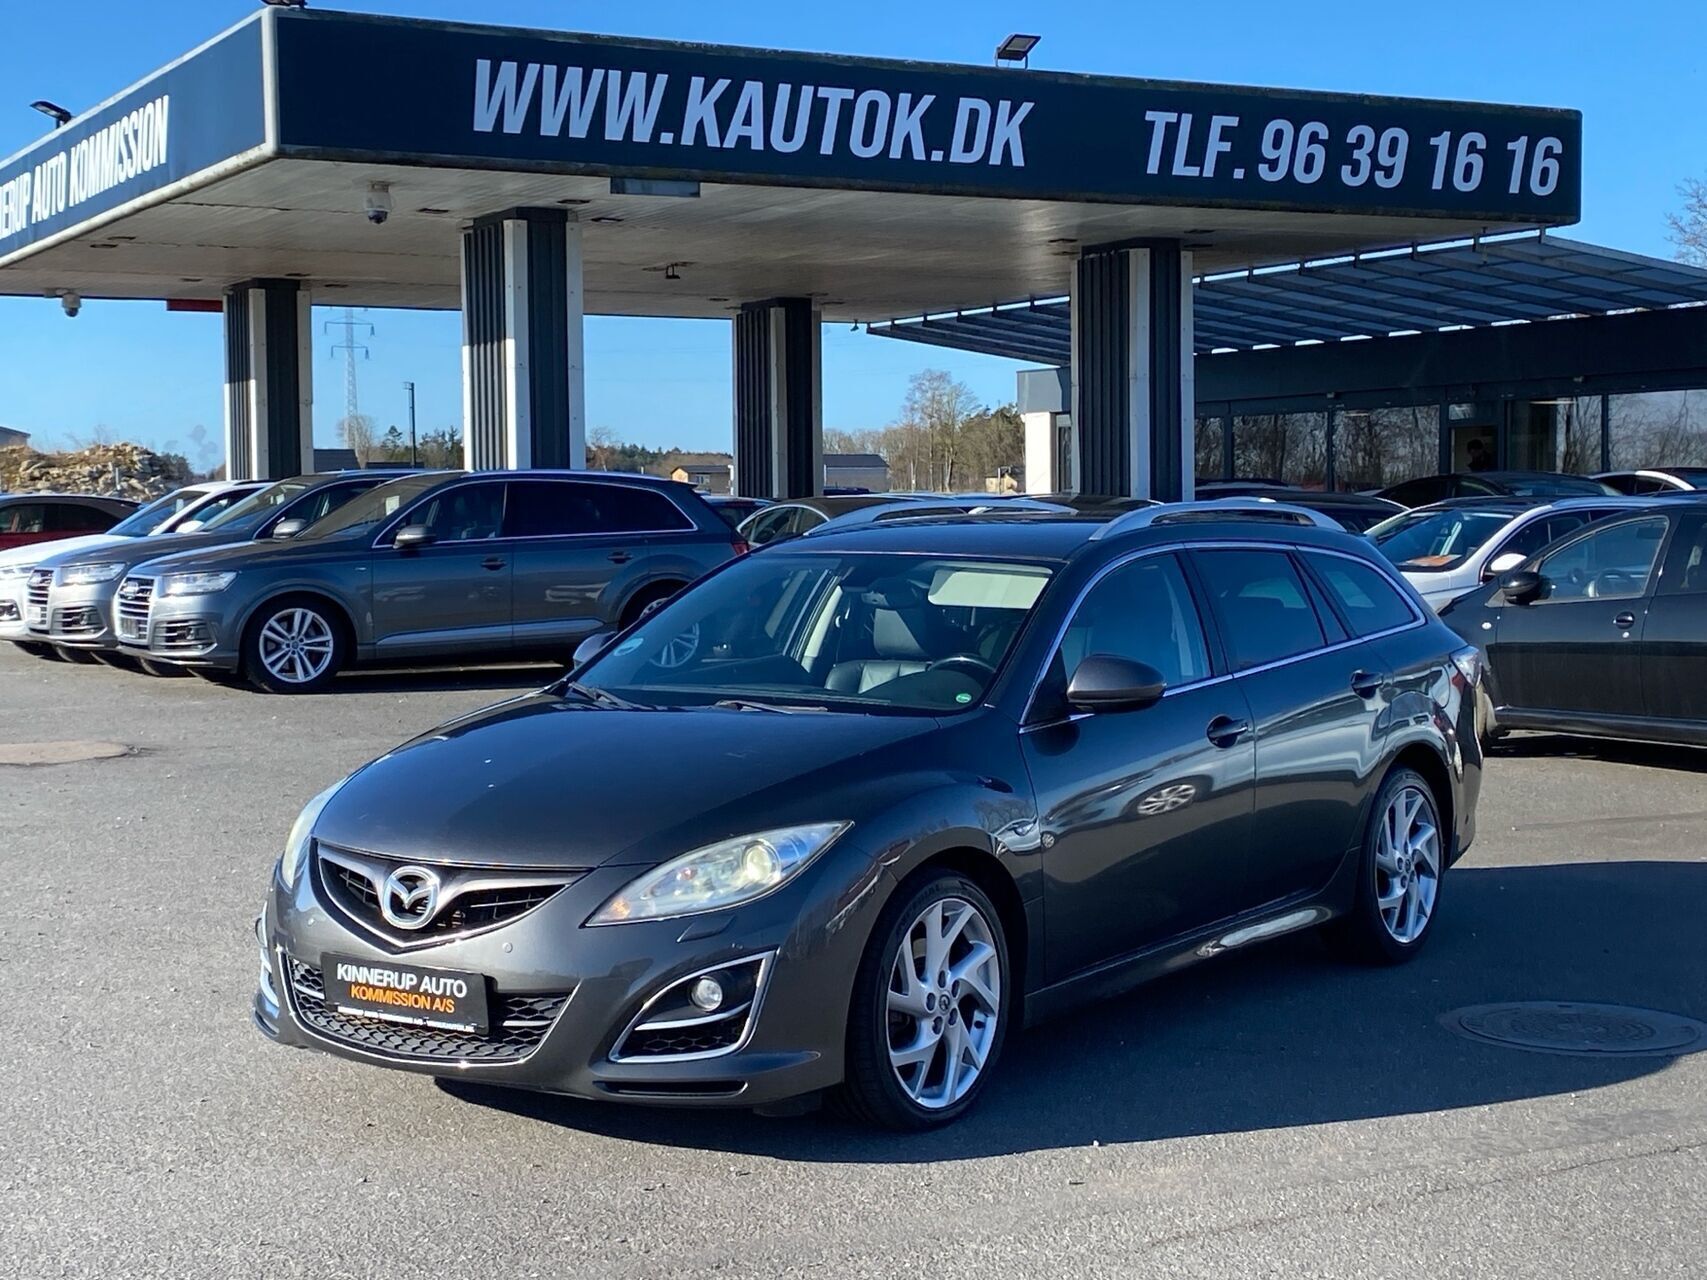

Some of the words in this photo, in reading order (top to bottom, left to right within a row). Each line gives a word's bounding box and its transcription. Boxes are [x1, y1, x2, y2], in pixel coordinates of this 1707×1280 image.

[473, 59, 1034, 167] WWW.KAUTOK.DK
[1144, 110, 1244, 179] TLF.
[1257, 118, 1329, 185] 96
[1340, 124, 1409, 189] 39
[1429, 130, 1487, 193] 16
[1506, 135, 1563, 196] 16
[31, 151, 67, 224] AUTO
[69, 95, 169, 207] KOMMISSION
[337, 963, 417, 989] KINNERUP
[419, 975, 467, 999] AUTO
[351, 984, 431, 1010] KOMMISSION
[433, 997, 455, 1013] A/S
